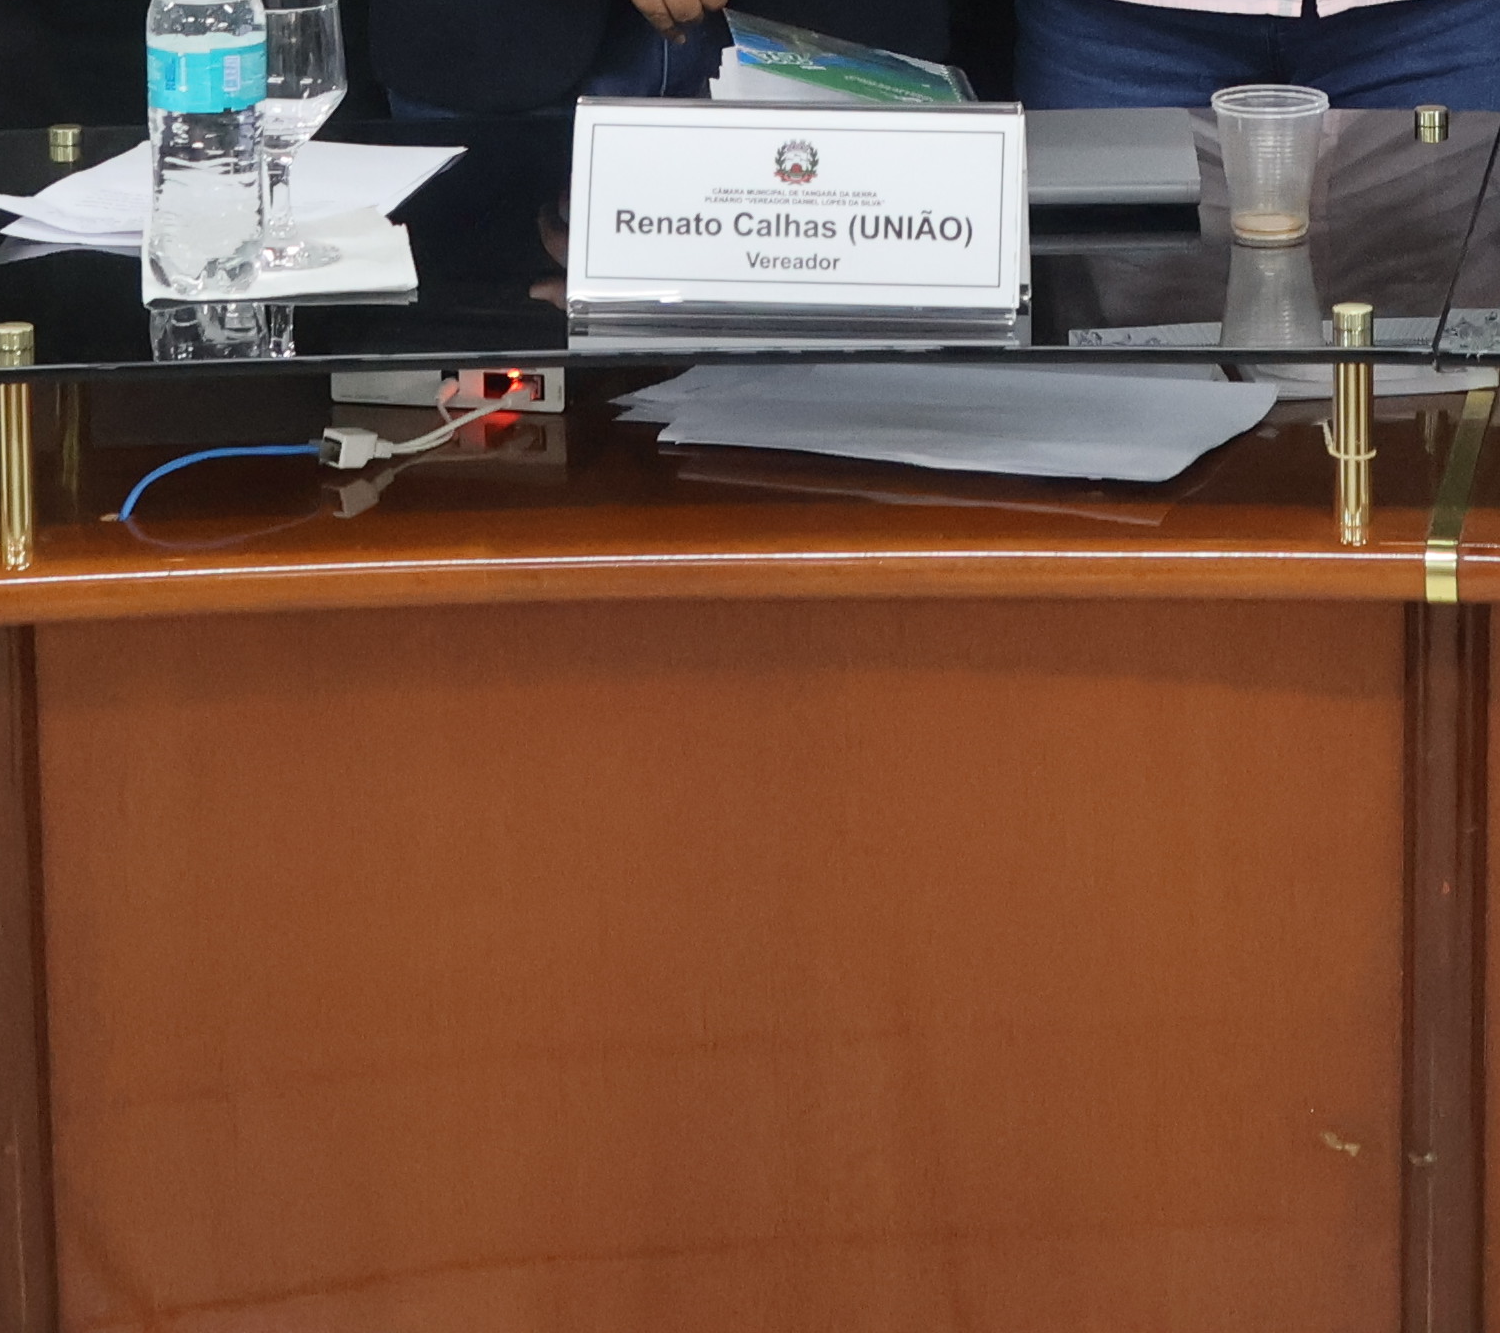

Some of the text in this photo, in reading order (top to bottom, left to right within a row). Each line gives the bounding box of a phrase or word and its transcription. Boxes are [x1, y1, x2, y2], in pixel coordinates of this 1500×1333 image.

[615, 209, 974, 248] Renato Calhas (UNIÃO)
[746, 252, 840, 271] Vereador
